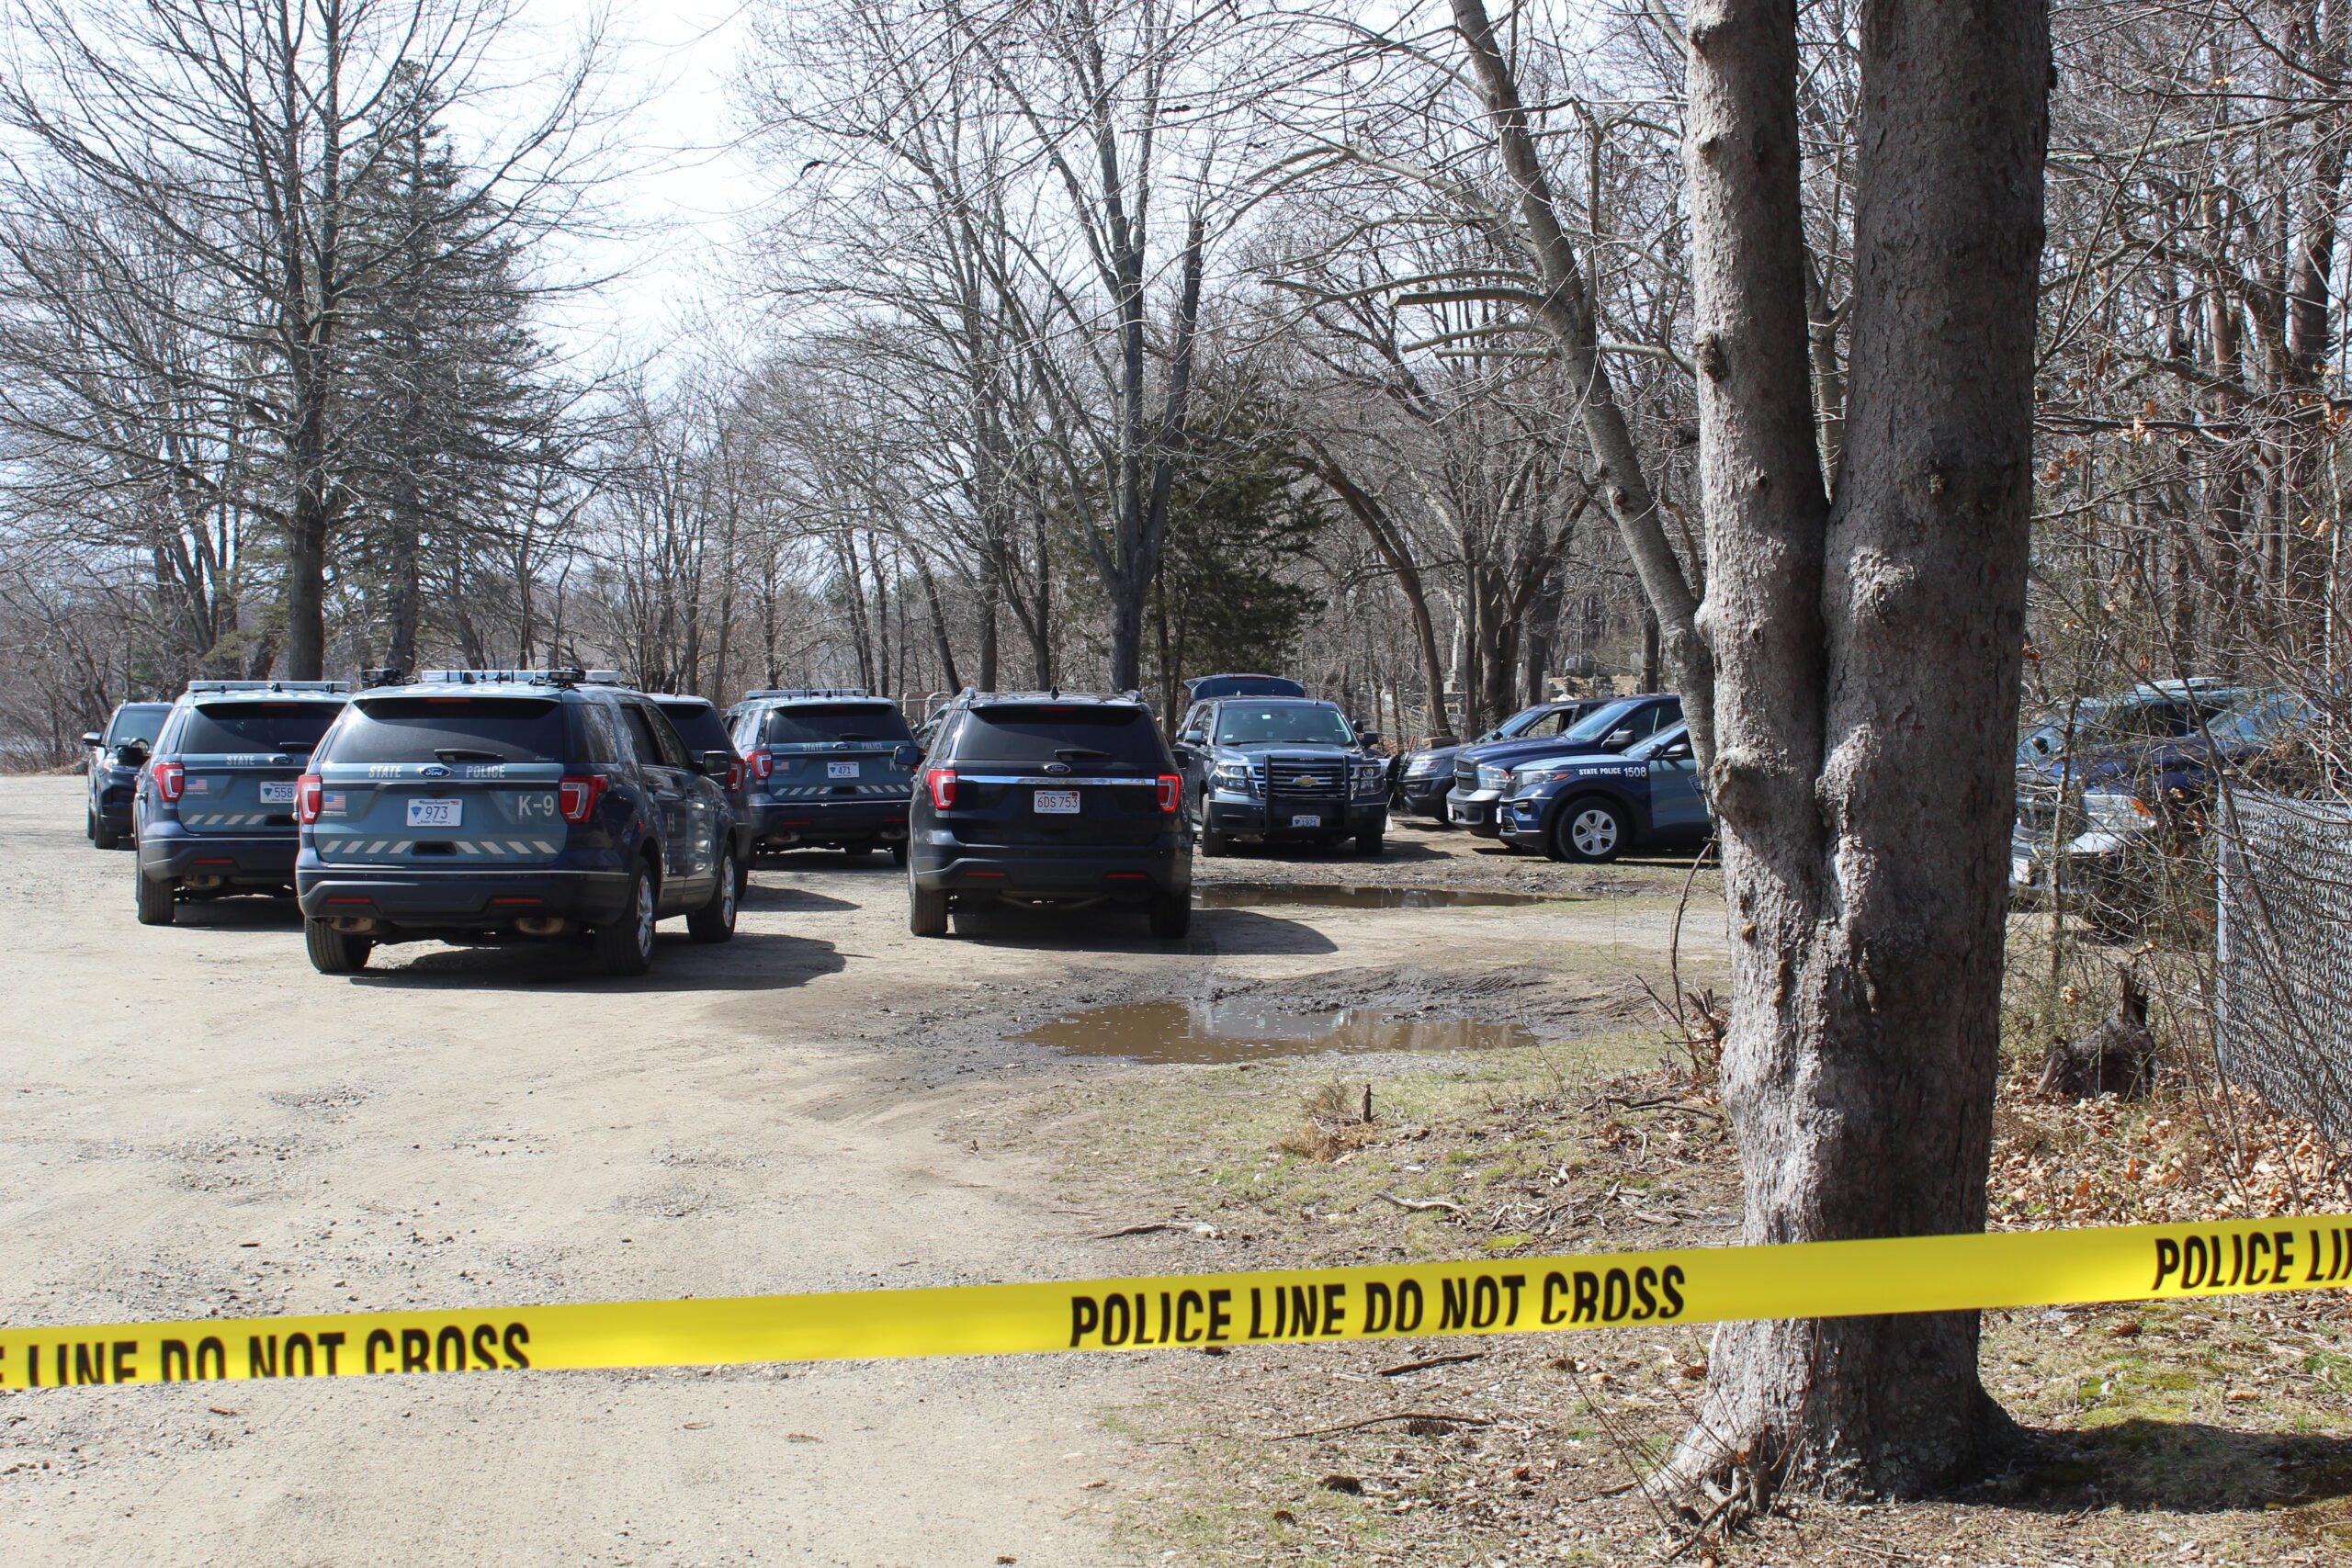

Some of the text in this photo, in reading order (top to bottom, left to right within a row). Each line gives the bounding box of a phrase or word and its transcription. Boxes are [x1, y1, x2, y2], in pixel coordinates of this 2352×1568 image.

[226, 755, 255, 765] STATE
[368, 765, 401, 778] STATE
[466, 765, 505, 778] POLICE
[1623, 766, 1646, 777] 1508
[275, 787, 293, 797] 558
[518, 795, 555, 817] K-9
[1058, 796, 1078, 808] 753
[425, 806, 448, 819] 973
[2151, 1232, 2294, 1291] POLICE
[1069, 1265, 1686, 1348] POLICE LINE DO NOT CROSS
[248, 1331, 346, 1378] NOT
[367, 1323, 531, 1374] CROSS
